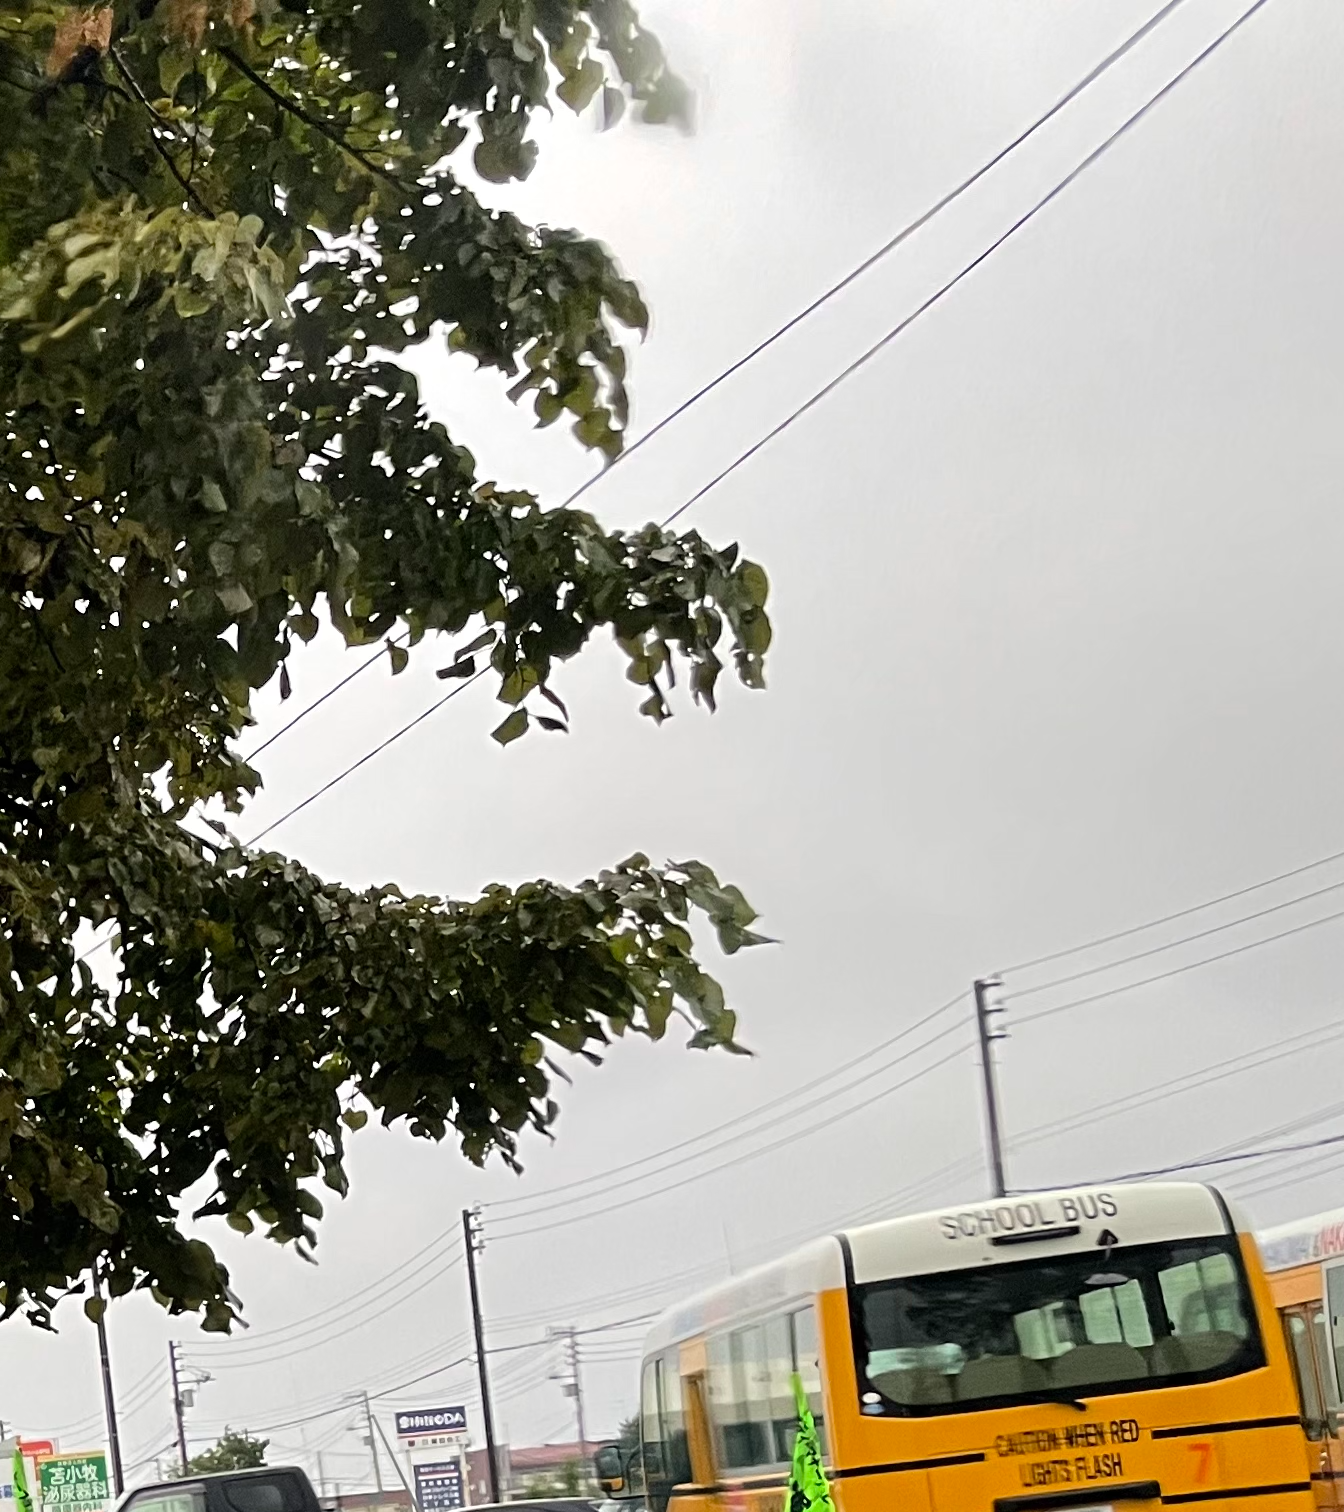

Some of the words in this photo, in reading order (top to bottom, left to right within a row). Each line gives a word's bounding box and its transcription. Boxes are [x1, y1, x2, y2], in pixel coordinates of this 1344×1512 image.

[939, 1202, 1055, 1240] SCHOOL
[1060, 1193, 1118, 1222] BUS
[1110, 1418, 1140, 1444] RED
[48, 1463, 99, 1485] 苫小牧
[1074, 1452, 1124, 1481] FLASH
[1187, 1443, 1211, 1485] 7
[42, 1480, 108, 1503] 泌尿器科
